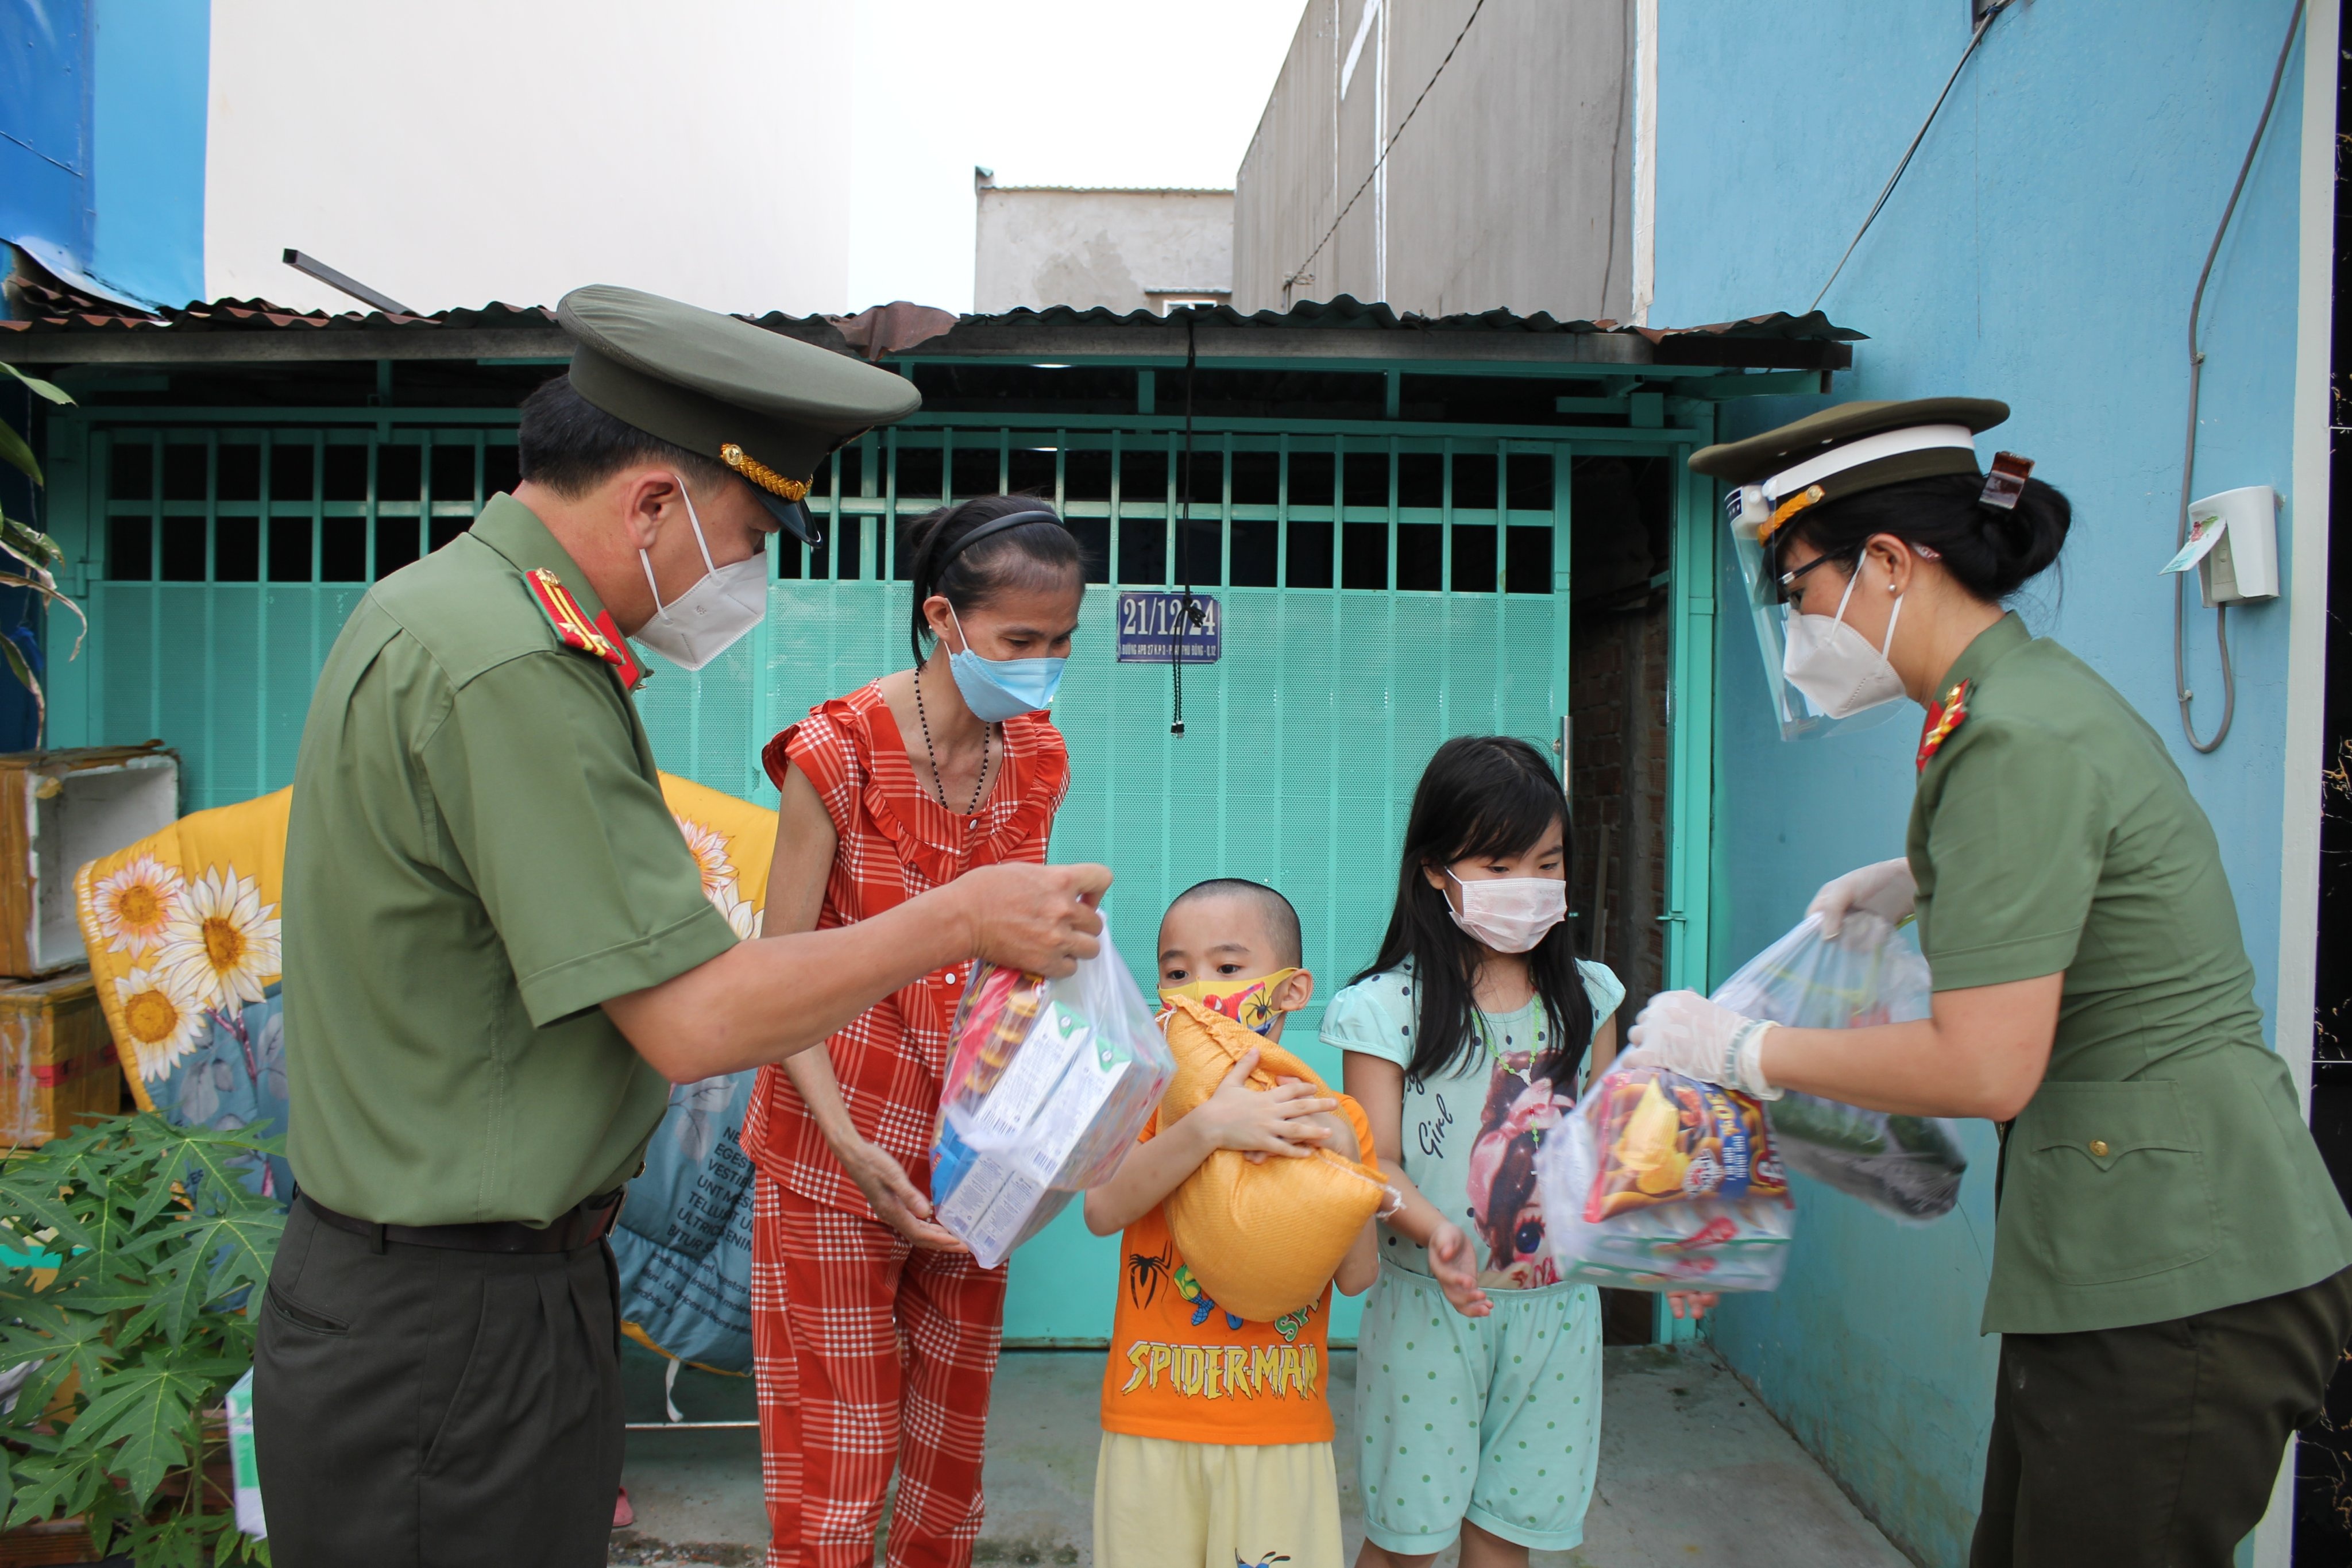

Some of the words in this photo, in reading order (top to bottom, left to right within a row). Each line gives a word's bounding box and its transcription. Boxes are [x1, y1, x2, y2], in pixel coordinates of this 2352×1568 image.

[1419, 1093, 1453, 1159] Girl
[697, 1175, 724, 1198] UNT
[1121, 1341, 1319, 1401] SPIDER-MAN
